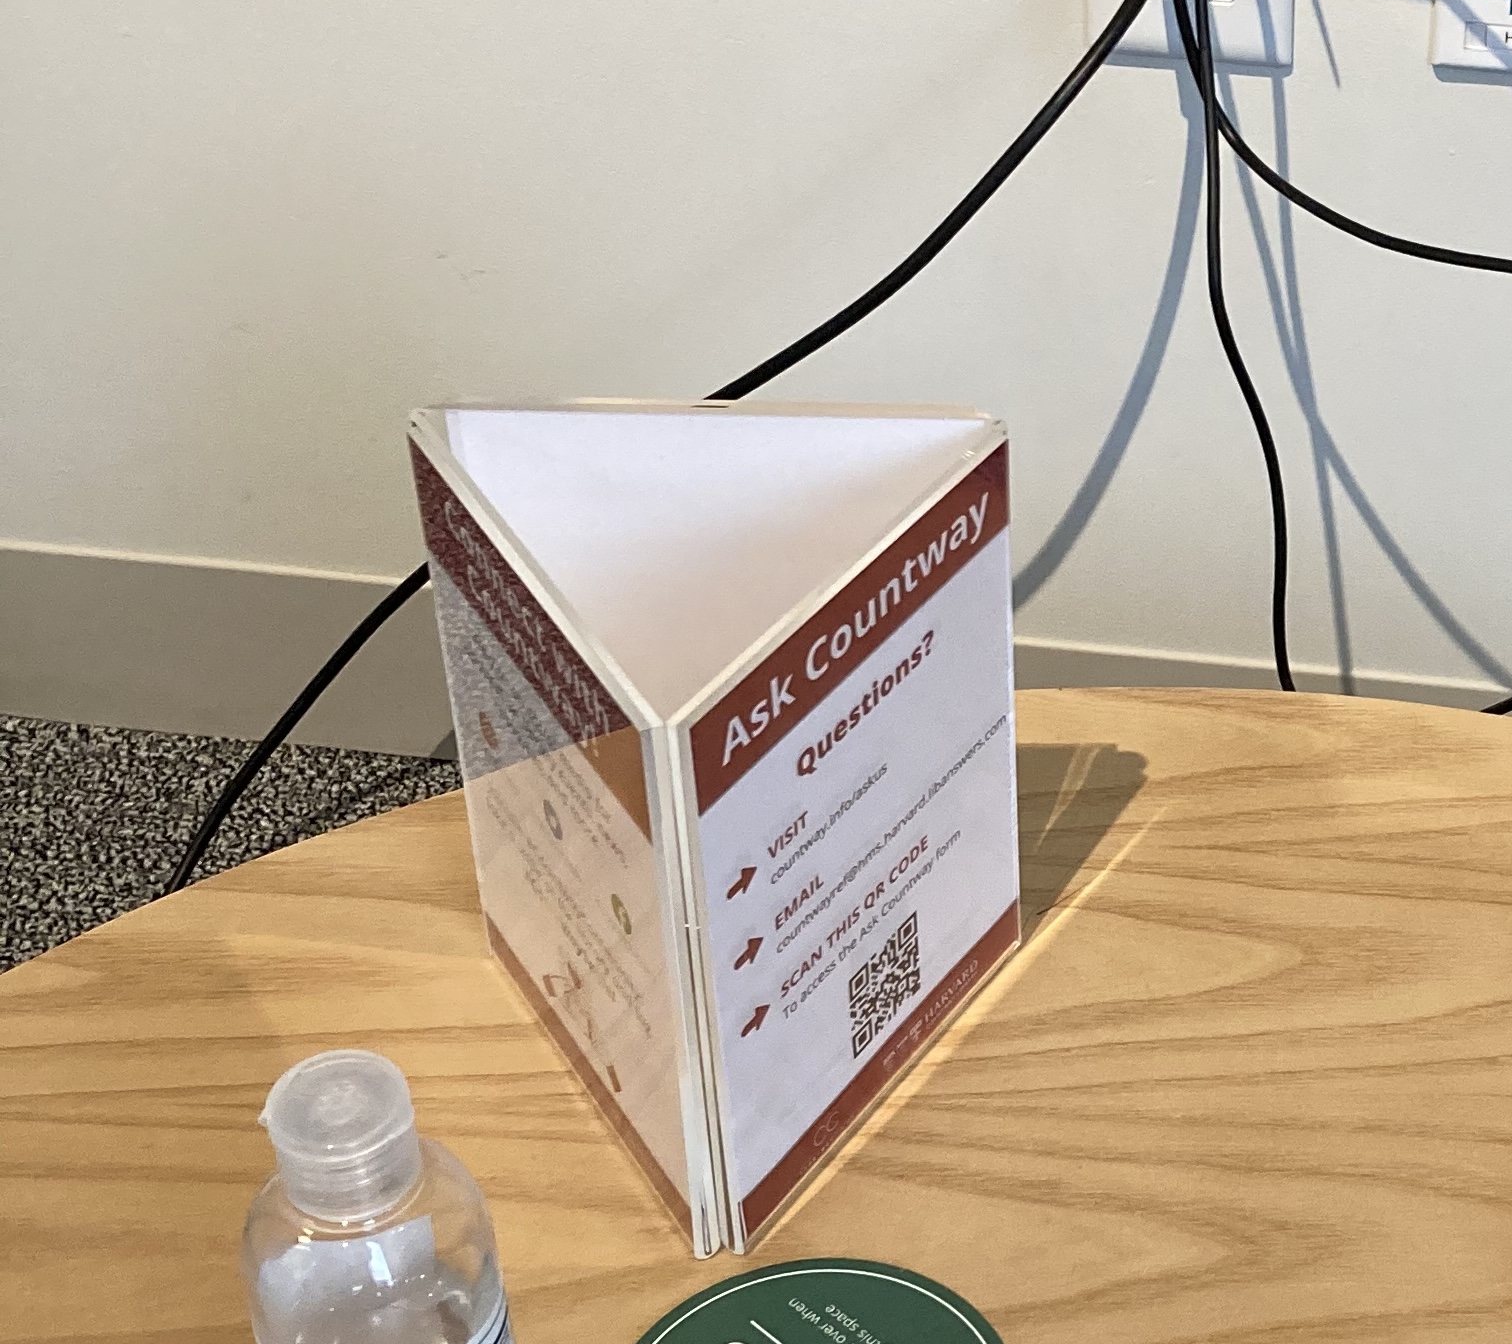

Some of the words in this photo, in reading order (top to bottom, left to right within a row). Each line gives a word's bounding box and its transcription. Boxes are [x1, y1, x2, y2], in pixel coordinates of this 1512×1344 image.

[721, 673, 796, 767] Ask
[805, 492, 989, 682] Countway
[796, 629, 935, 776] Questions?
[767, 810, 809, 859] VISIT
[775, 874, 825, 931] EMAIL
[780, 945, 823, 999] SCAN
[826, 911, 861, 948] THIS
[863, 881, 886, 911] QR
[888, 835, 930, 884] CODE
[782, 1001, 799, 1020] To
[800, 959, 837, 1004] access
[838, 936, 858, 964] the
[858, 914, 880, 939] Ask
[880, 859, 935, 917] Countway
[935, 829, 962, 862] form
[925, 959, 979, 1023] HARVARD
[788, 1297, 821, 1325] when
[817, 1323, 846, 1344] over
[825, 1304, 860, 1332] space
